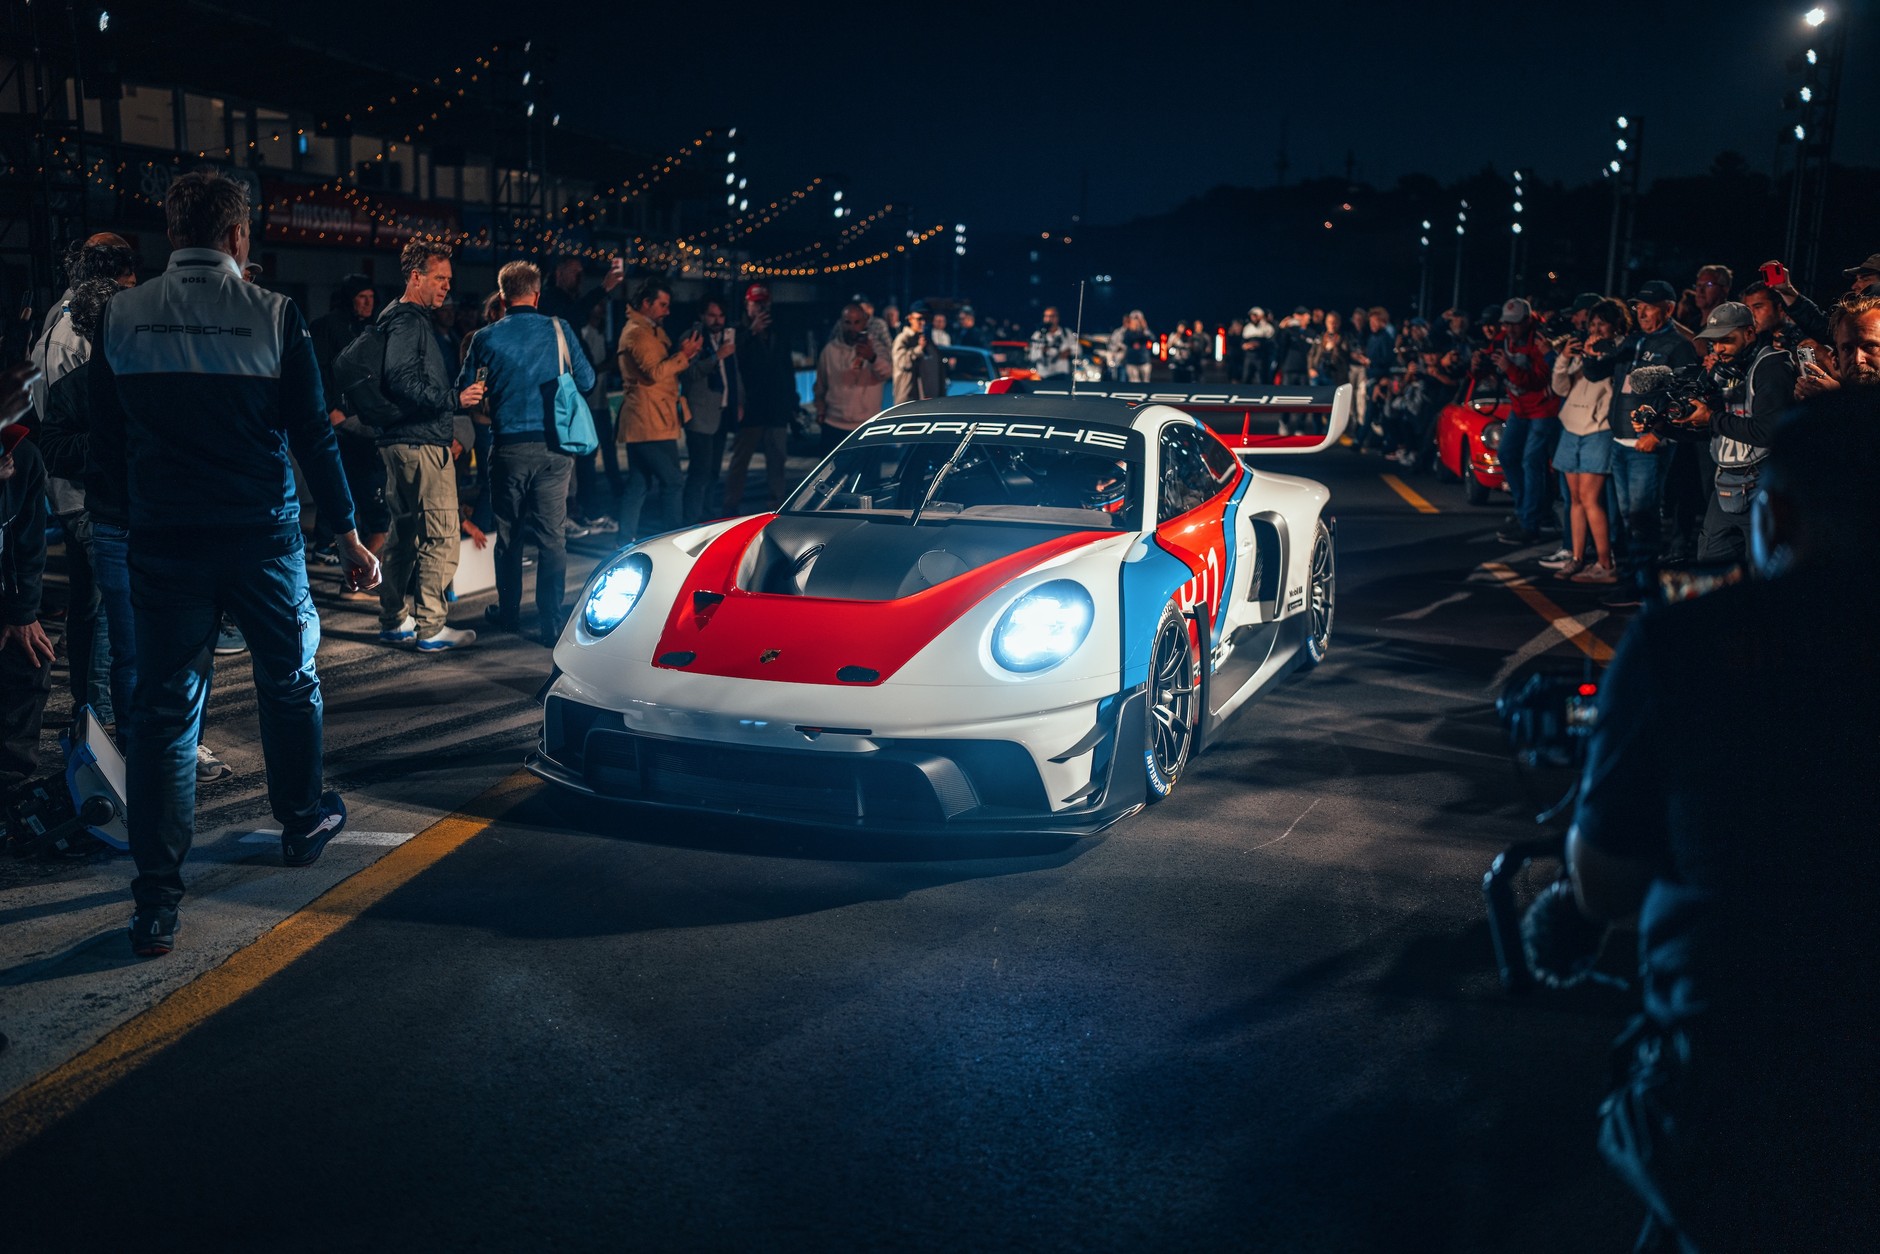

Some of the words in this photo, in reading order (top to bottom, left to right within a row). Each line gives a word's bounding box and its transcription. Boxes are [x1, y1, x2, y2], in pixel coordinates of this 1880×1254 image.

[181, 276, 208, 285] BOSS
[135, 324, 252, 337] PORSCHE
[858, 421, 1128, 451] PORSCHE
